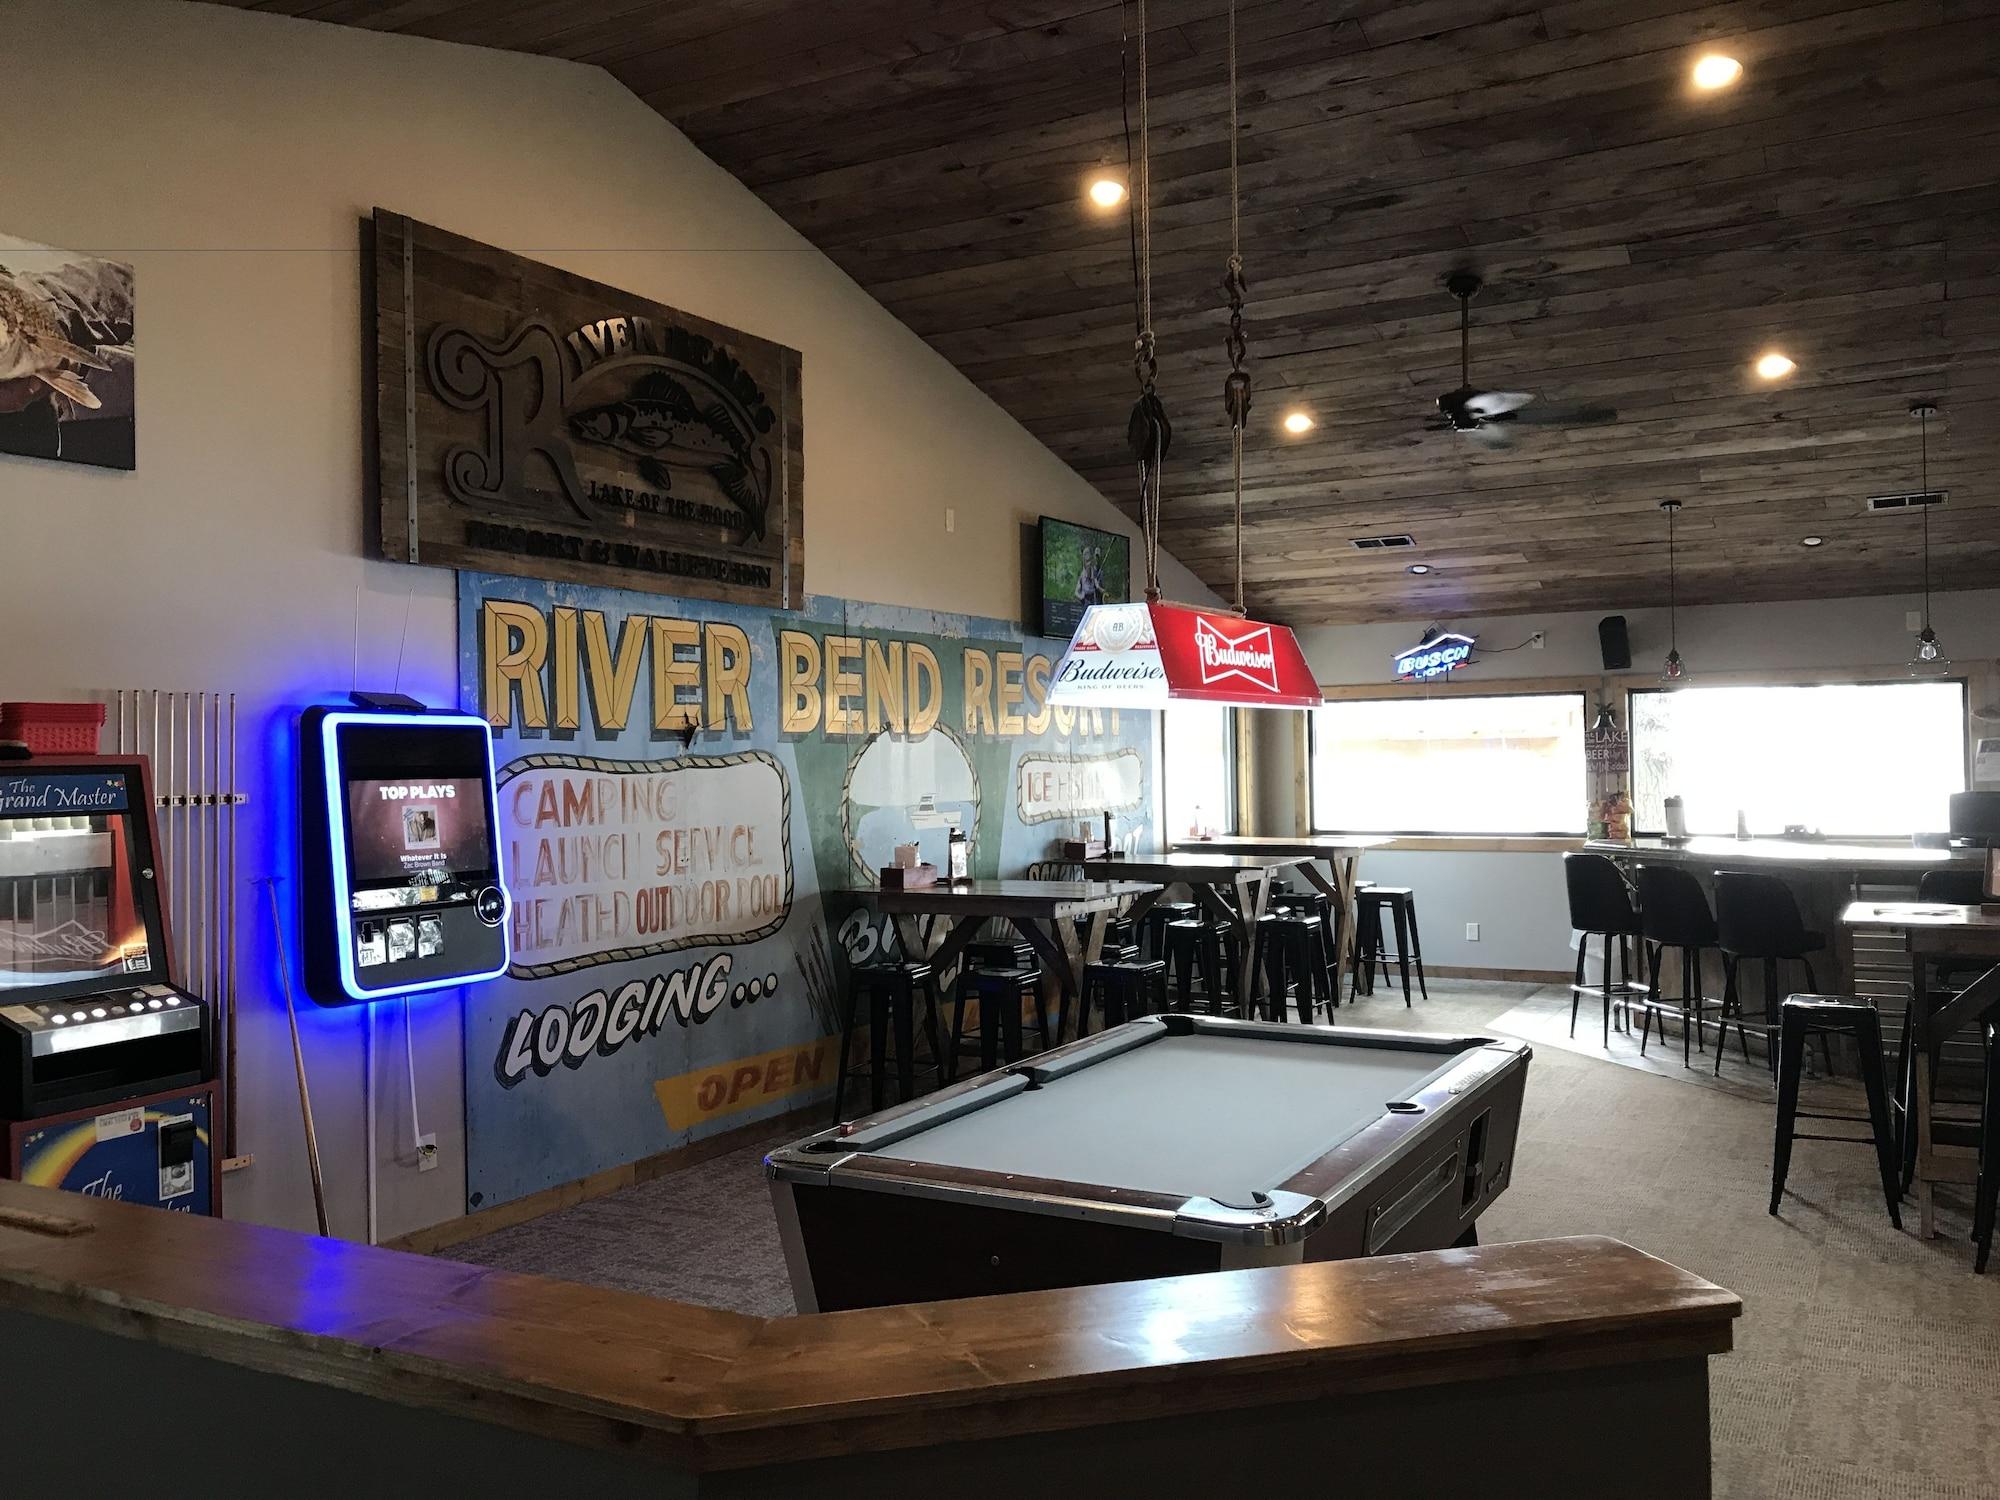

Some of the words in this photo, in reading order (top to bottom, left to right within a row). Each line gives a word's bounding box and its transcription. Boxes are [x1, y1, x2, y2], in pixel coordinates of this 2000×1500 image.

[587, 481, 636, 508] LAKE
[641, 491, 661, 513] OF
[665, 498, 697, 522] THE
[1195, 632, 1274, 670] Budweiser
[1397, 645, 1469, 674] BUSCH
[478, 598, 754, 741] RIVER
[778, 630, 943, 736] BEND
[1415, 662, 1456, 679] LIGHT
[1596, 730, 1628, 743] LAKE
[1586, 750, 1610, 760] BEER
[9, 779, 36, 794] The
[54, 787, 117, 807] Master
[380, 786, 408, 800] TOP
[410, 785, 456, 799] PLAYS
[1027, 772, 1052, 802] ICE
[512, 777, 677, 829] CAMPING
[400, 854, 433, 862] Whatever
[655, 824, 763, 877] SERVICE
[513, 891, 631, 952] HEATED
[636, 879, 731, 935] OUTDOOR
[736, 873, 784, 918] POOL
[697, 1047, 826, 1111] OPEN
[82, 1170, 123, 1200] The
